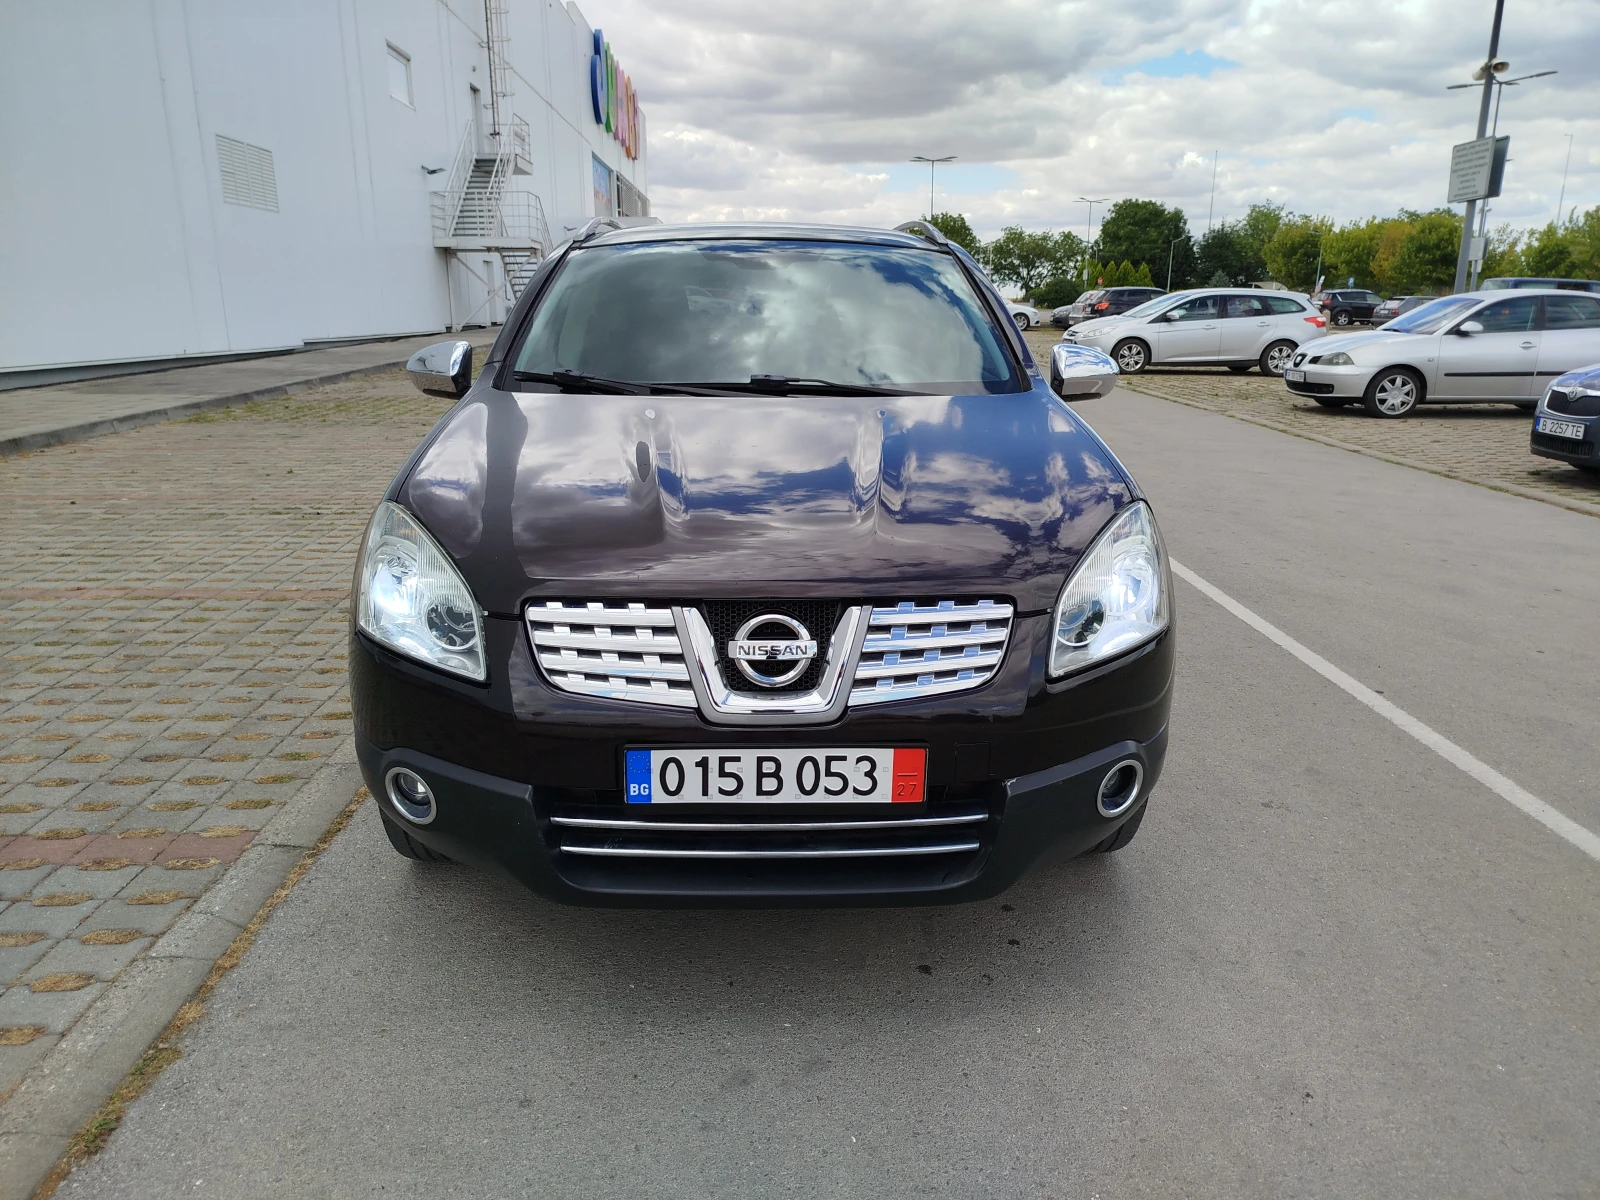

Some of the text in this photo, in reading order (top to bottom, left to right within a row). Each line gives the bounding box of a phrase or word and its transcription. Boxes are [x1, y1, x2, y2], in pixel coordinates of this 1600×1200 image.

[1541, 420, 1583, 437] B 2257 TE
[738, 644, 808, 656] NISSAN
[659, 754, 878, 797] 015 B 053
[629, 783, 650, 796] BG
[897, 782, 917, 796] 27
